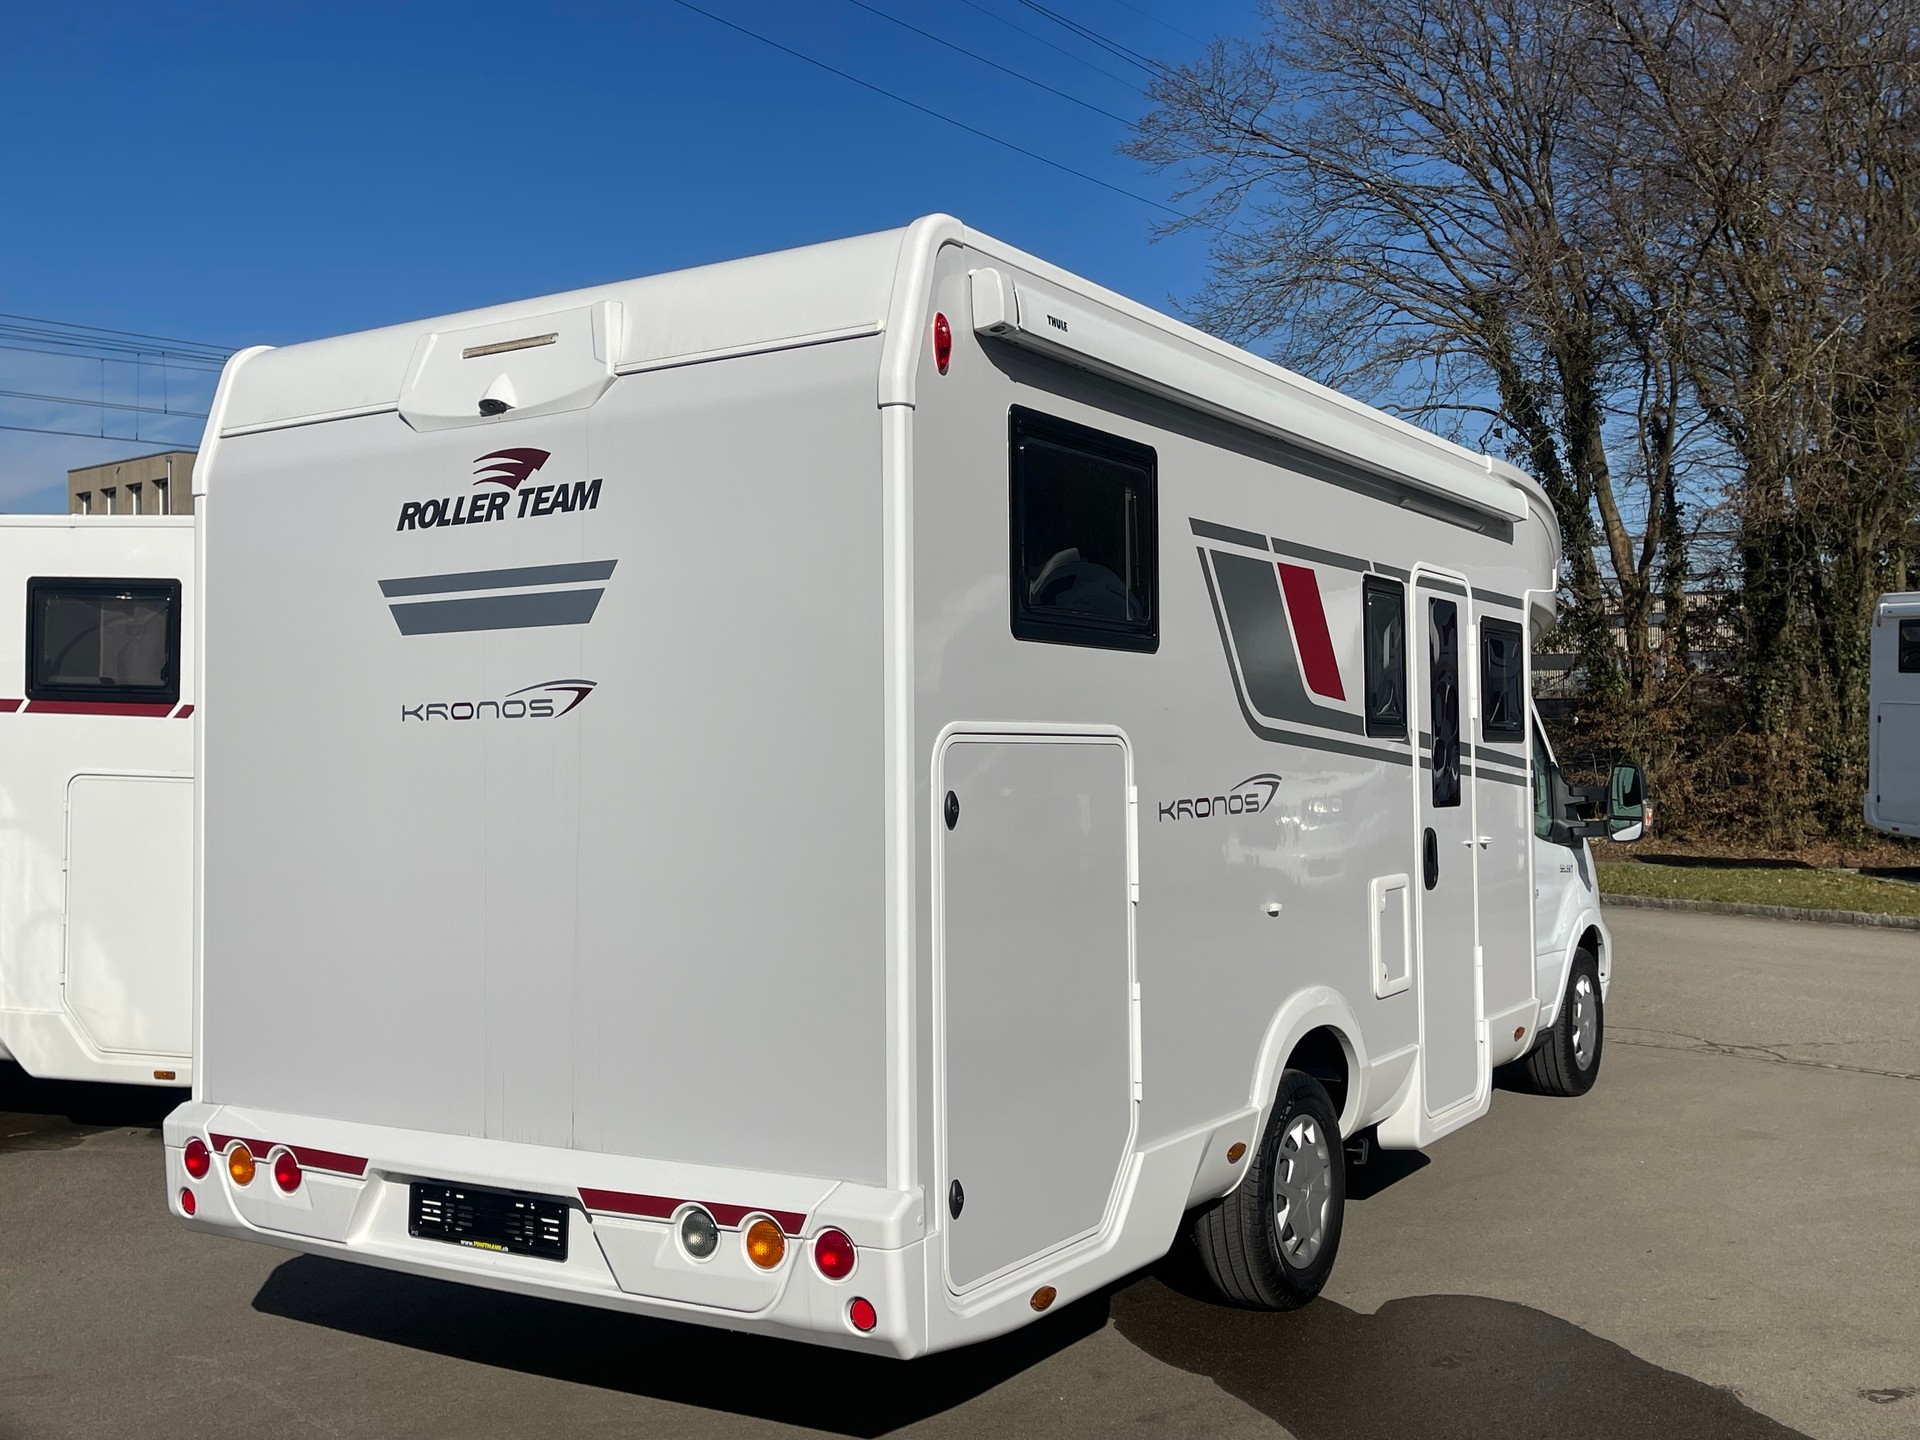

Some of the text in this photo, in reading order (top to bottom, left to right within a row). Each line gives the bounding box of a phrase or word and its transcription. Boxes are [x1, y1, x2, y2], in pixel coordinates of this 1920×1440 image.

[1046, 314, 1068, 333] THULE
[396, 478, 603, 531] ROLLER TEAM
[402, 698, 555, 722] KRONOS
[1158, 793, 1260, 822] KRONOS
